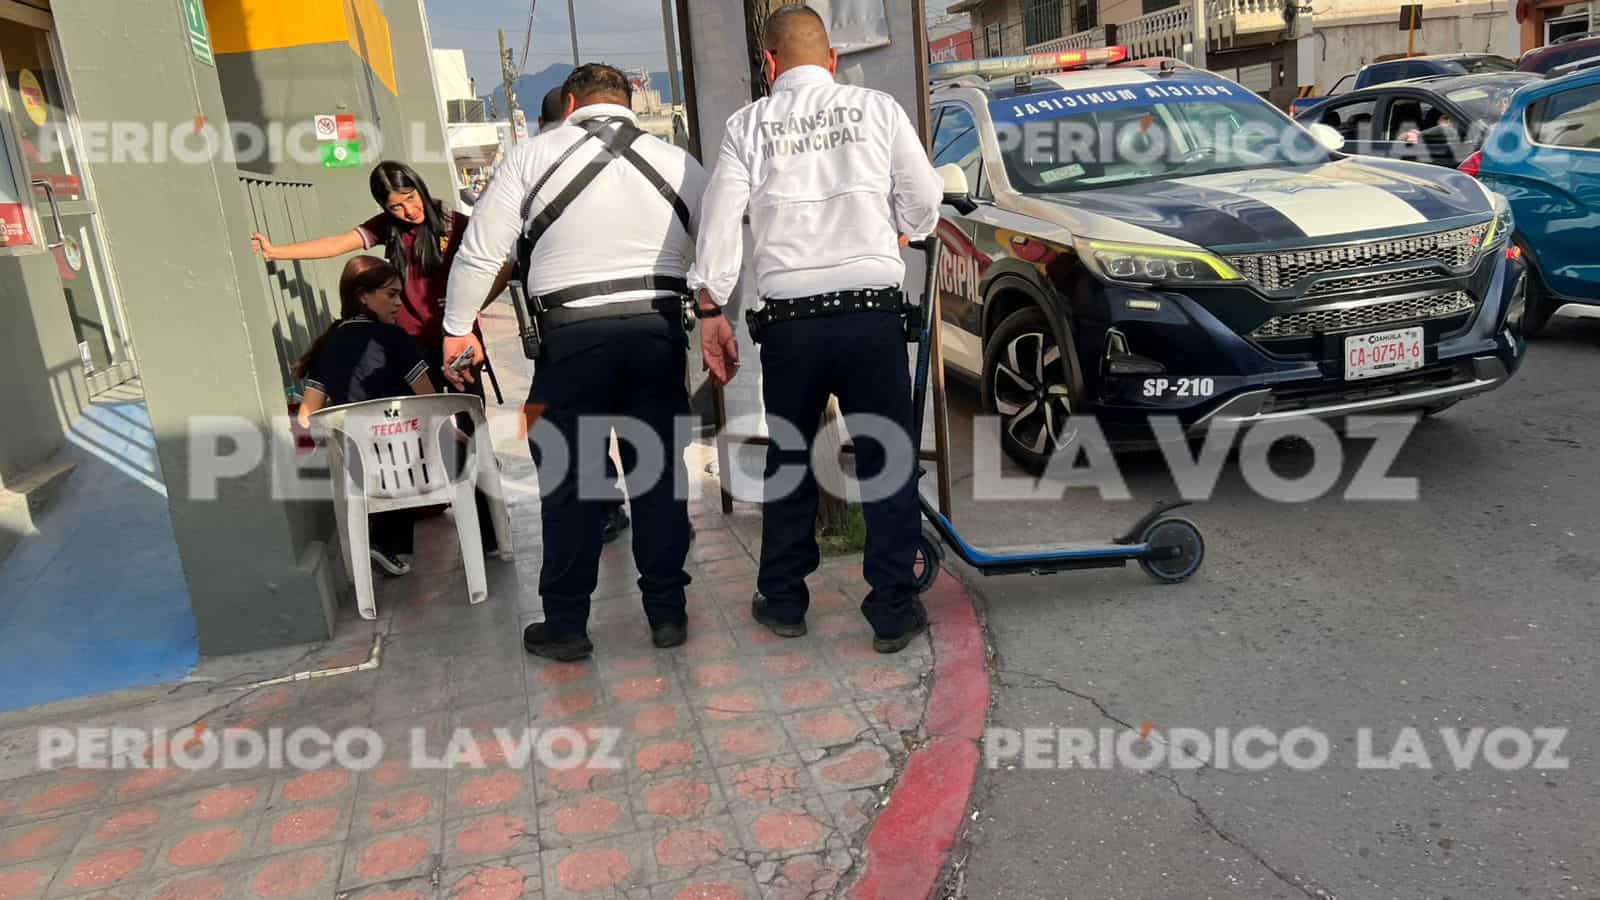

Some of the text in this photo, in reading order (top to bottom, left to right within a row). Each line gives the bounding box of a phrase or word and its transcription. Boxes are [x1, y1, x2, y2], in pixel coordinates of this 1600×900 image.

[759, 106, 864, 139] TRÁNSITO
[760, 125, 867, 161] MUNICIPAL
[1349, 340, 1420, 367] CA-075A-6
[1143, 377, 1215, 397] SP-210
[371, 418, 420, 436] TECATE
